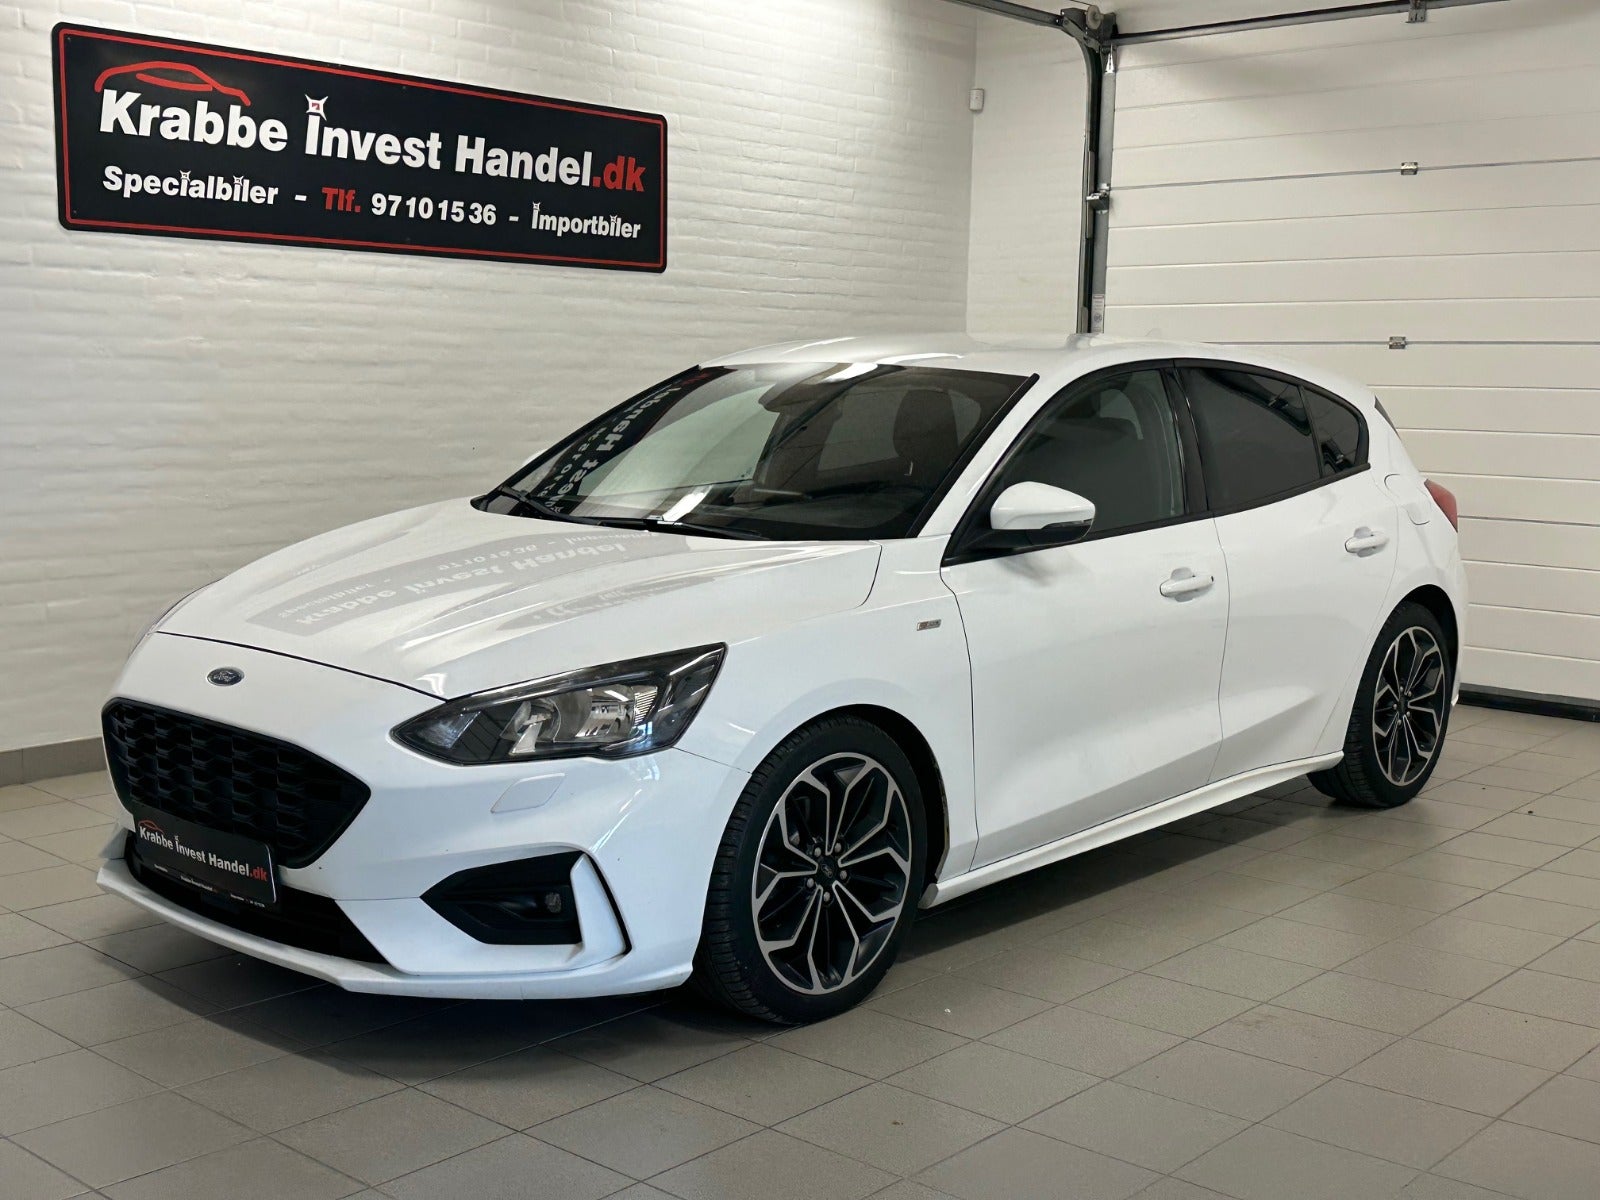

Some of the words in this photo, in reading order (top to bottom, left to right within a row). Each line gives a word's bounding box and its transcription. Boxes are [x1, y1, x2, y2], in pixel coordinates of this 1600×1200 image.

[99, 88, 288, 152] Krabbe
[455, 134, 646, 192] Handel.dk
[102, 165, 279, 204] Specialbiler
[322, 186, 361, 213] Tlf.
[139, 826, 174, 850] Krabbe
[208, 852, 267, 882] Handel.dk
